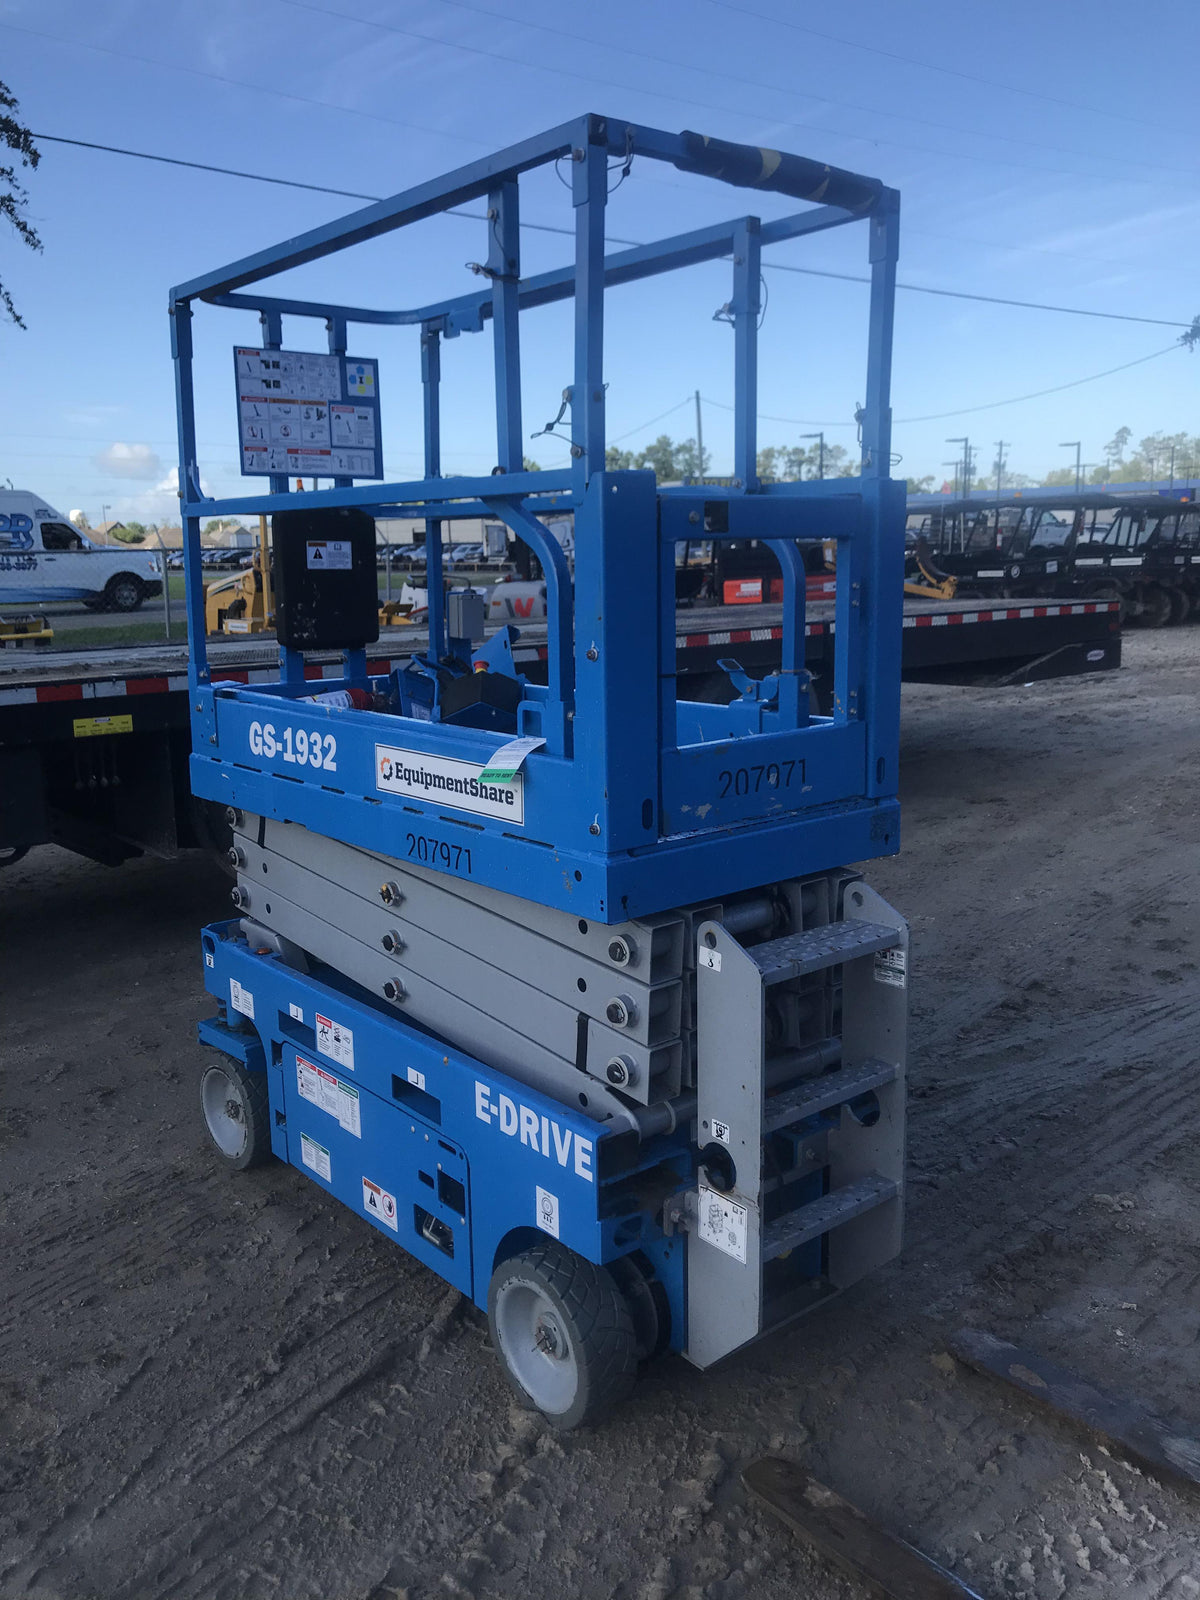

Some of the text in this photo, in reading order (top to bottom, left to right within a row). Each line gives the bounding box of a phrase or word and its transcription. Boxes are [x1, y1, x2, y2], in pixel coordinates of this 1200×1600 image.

[249, 721, 336, 772] GS-1932
[395, 762, 514, 805] EquipmentShare
[719, 758, 806, 799] 207971
[406, 833, 471, 874] 207971
[475, 1080, 593, 1183] E-DRIVE
